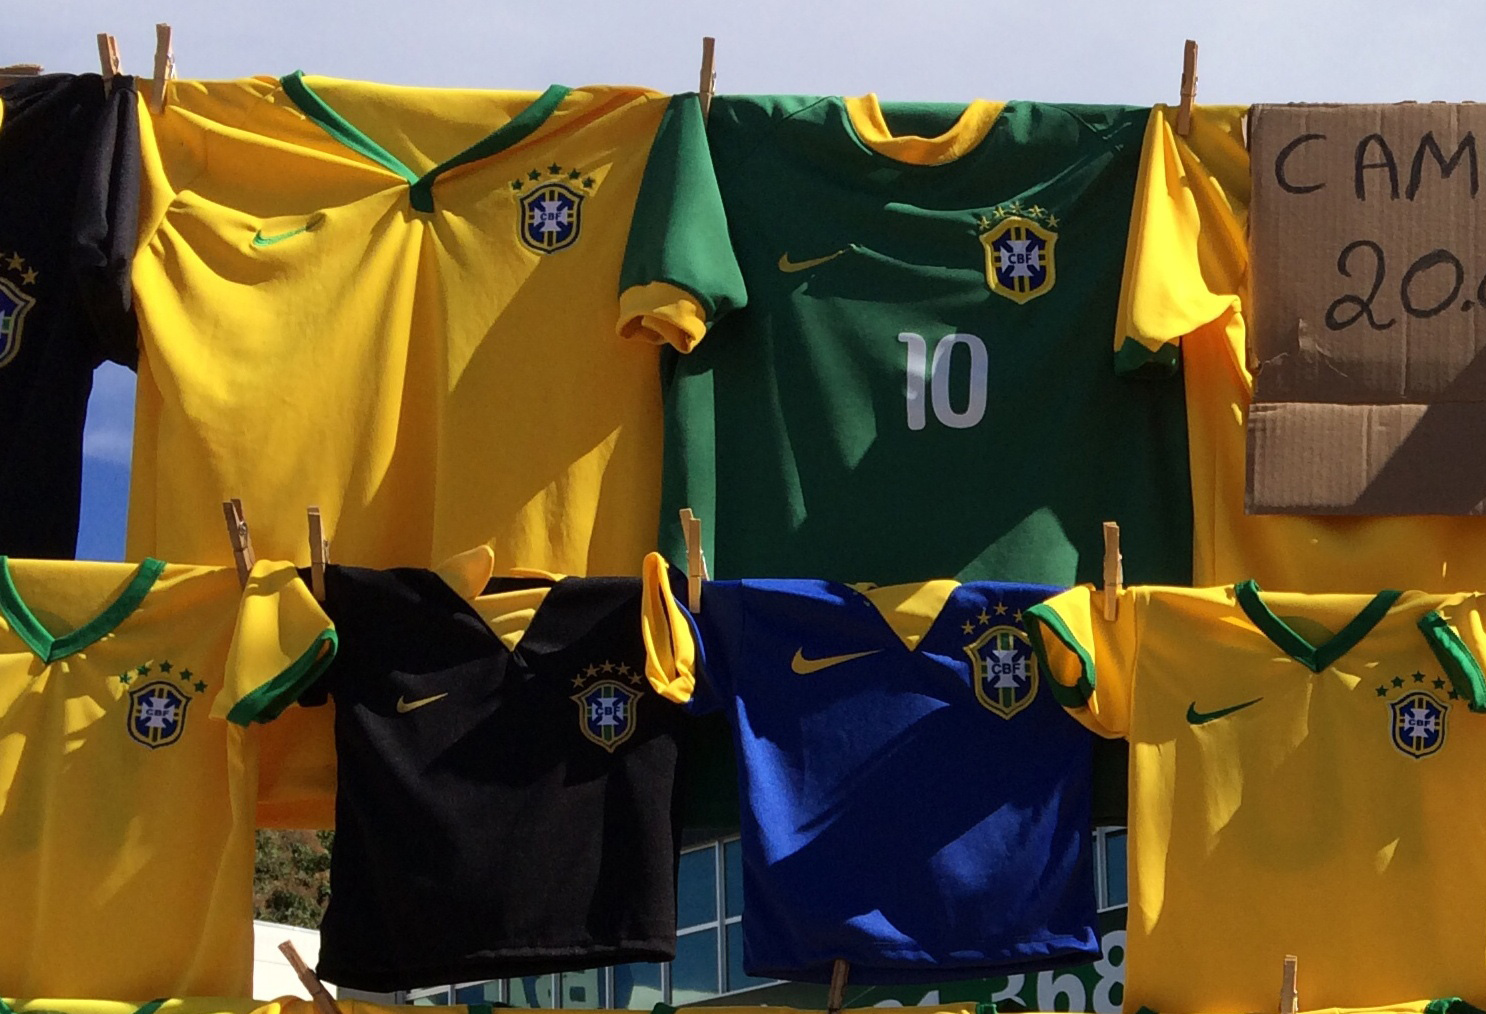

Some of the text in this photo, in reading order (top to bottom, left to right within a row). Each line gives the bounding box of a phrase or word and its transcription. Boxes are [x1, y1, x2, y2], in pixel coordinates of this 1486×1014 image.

[540, 212, 562, 222] CBF
[1008, 253, 1033, 265] CBF
[898, 332, 989, 431] 10
[991, 663, 1021, 675] CBF
[145, 708, 170, 717] CBF
[595, 706, 621, 716] CBF
[1408, 718, 1432, 727] CBF
